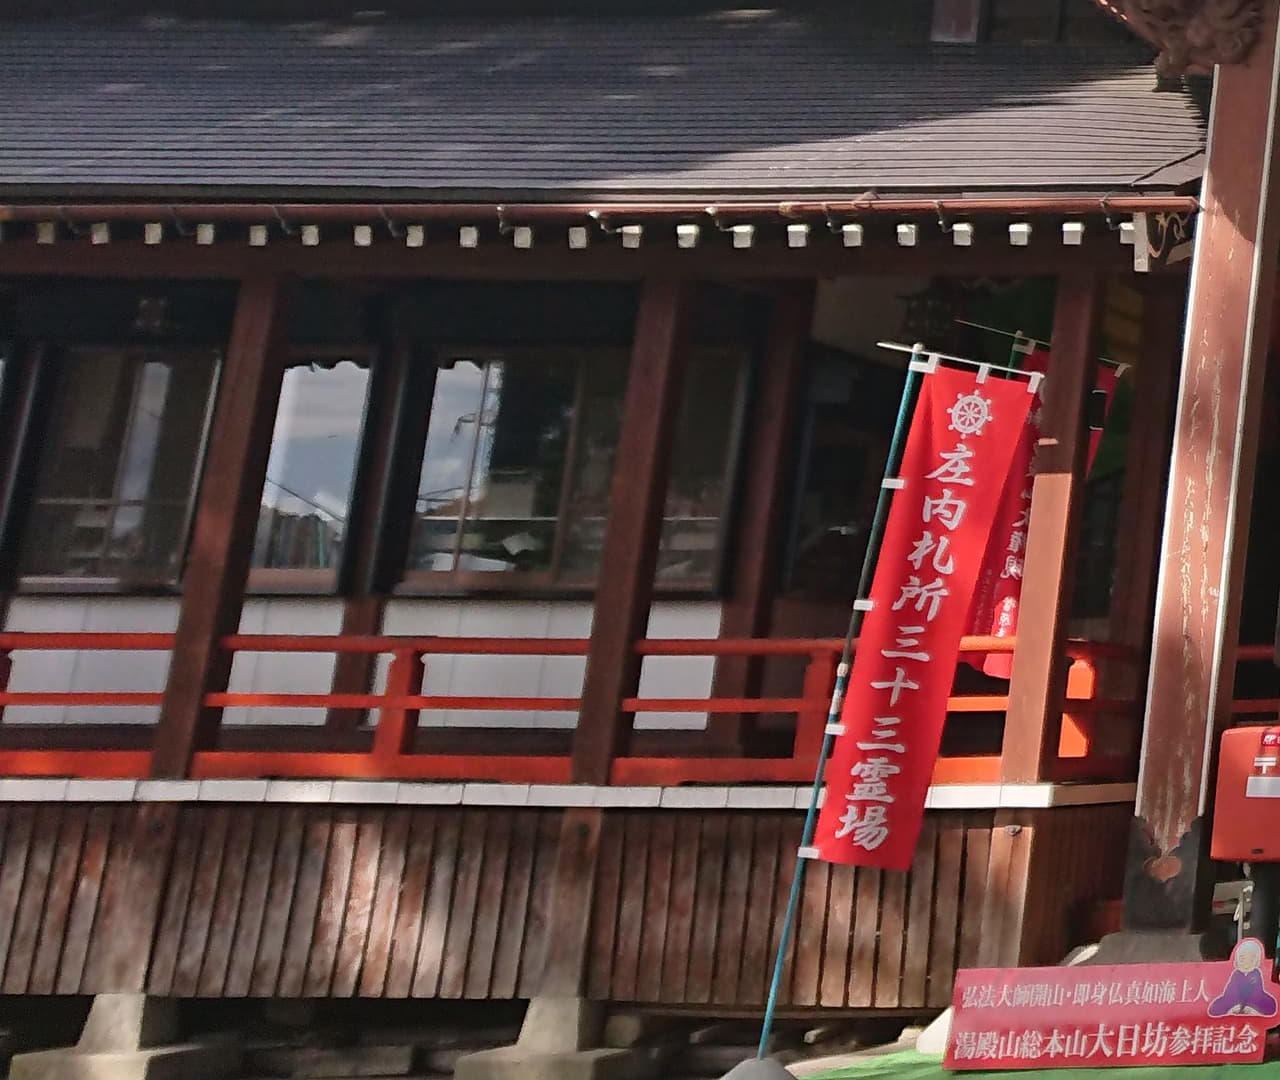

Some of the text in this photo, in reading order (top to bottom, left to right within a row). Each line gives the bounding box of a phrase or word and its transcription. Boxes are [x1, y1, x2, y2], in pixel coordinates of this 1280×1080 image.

[834, 442, 976, 852] 庄内札所三十三霊場
[953, 1021, 1259, 1061] 湯殿山総本山大日坊参拝記念
